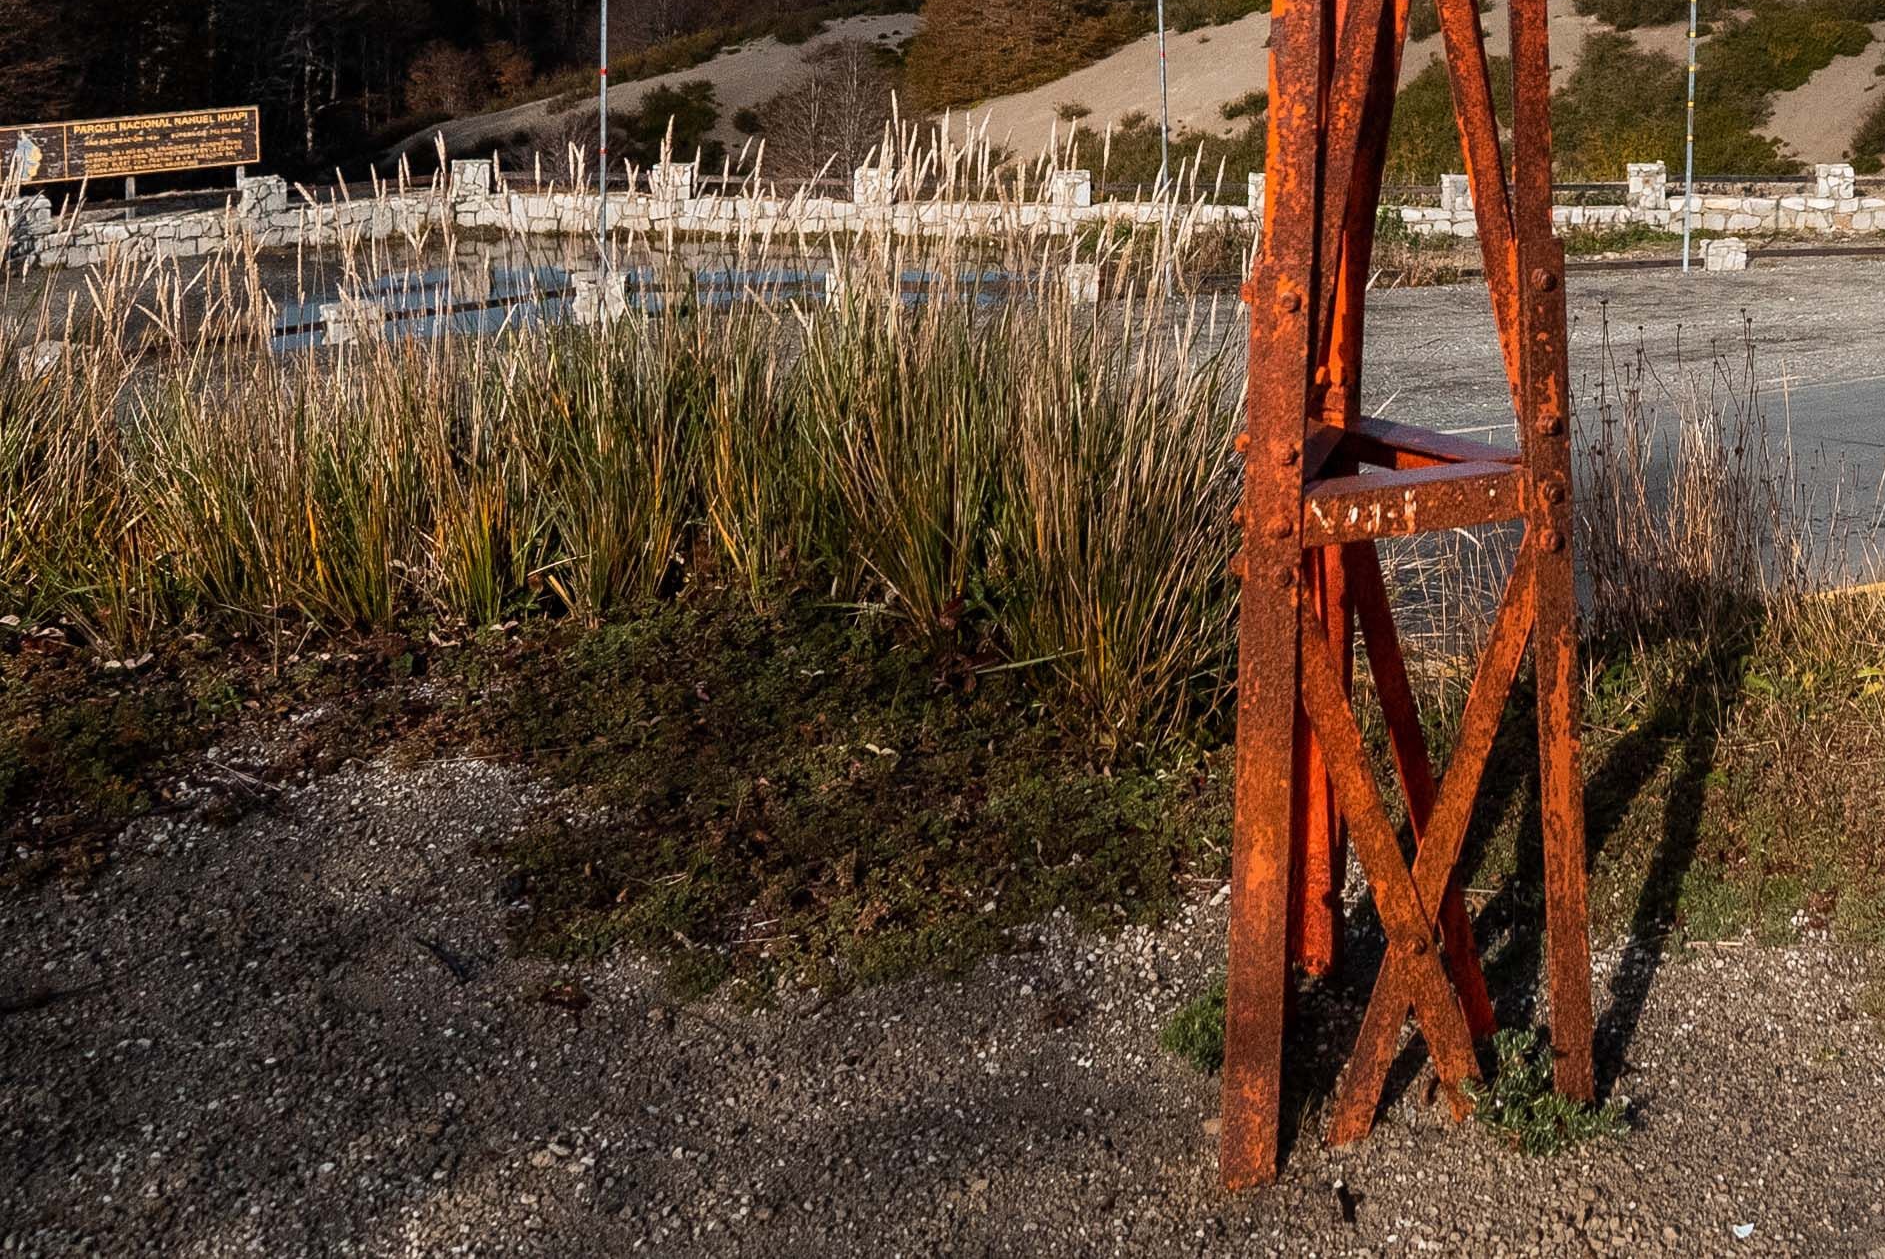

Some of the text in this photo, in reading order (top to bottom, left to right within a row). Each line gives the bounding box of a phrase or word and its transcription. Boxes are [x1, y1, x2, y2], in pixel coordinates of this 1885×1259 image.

[73, 112, 248, 134] PARQUE NACIONAL NAHUEL HUAPI
